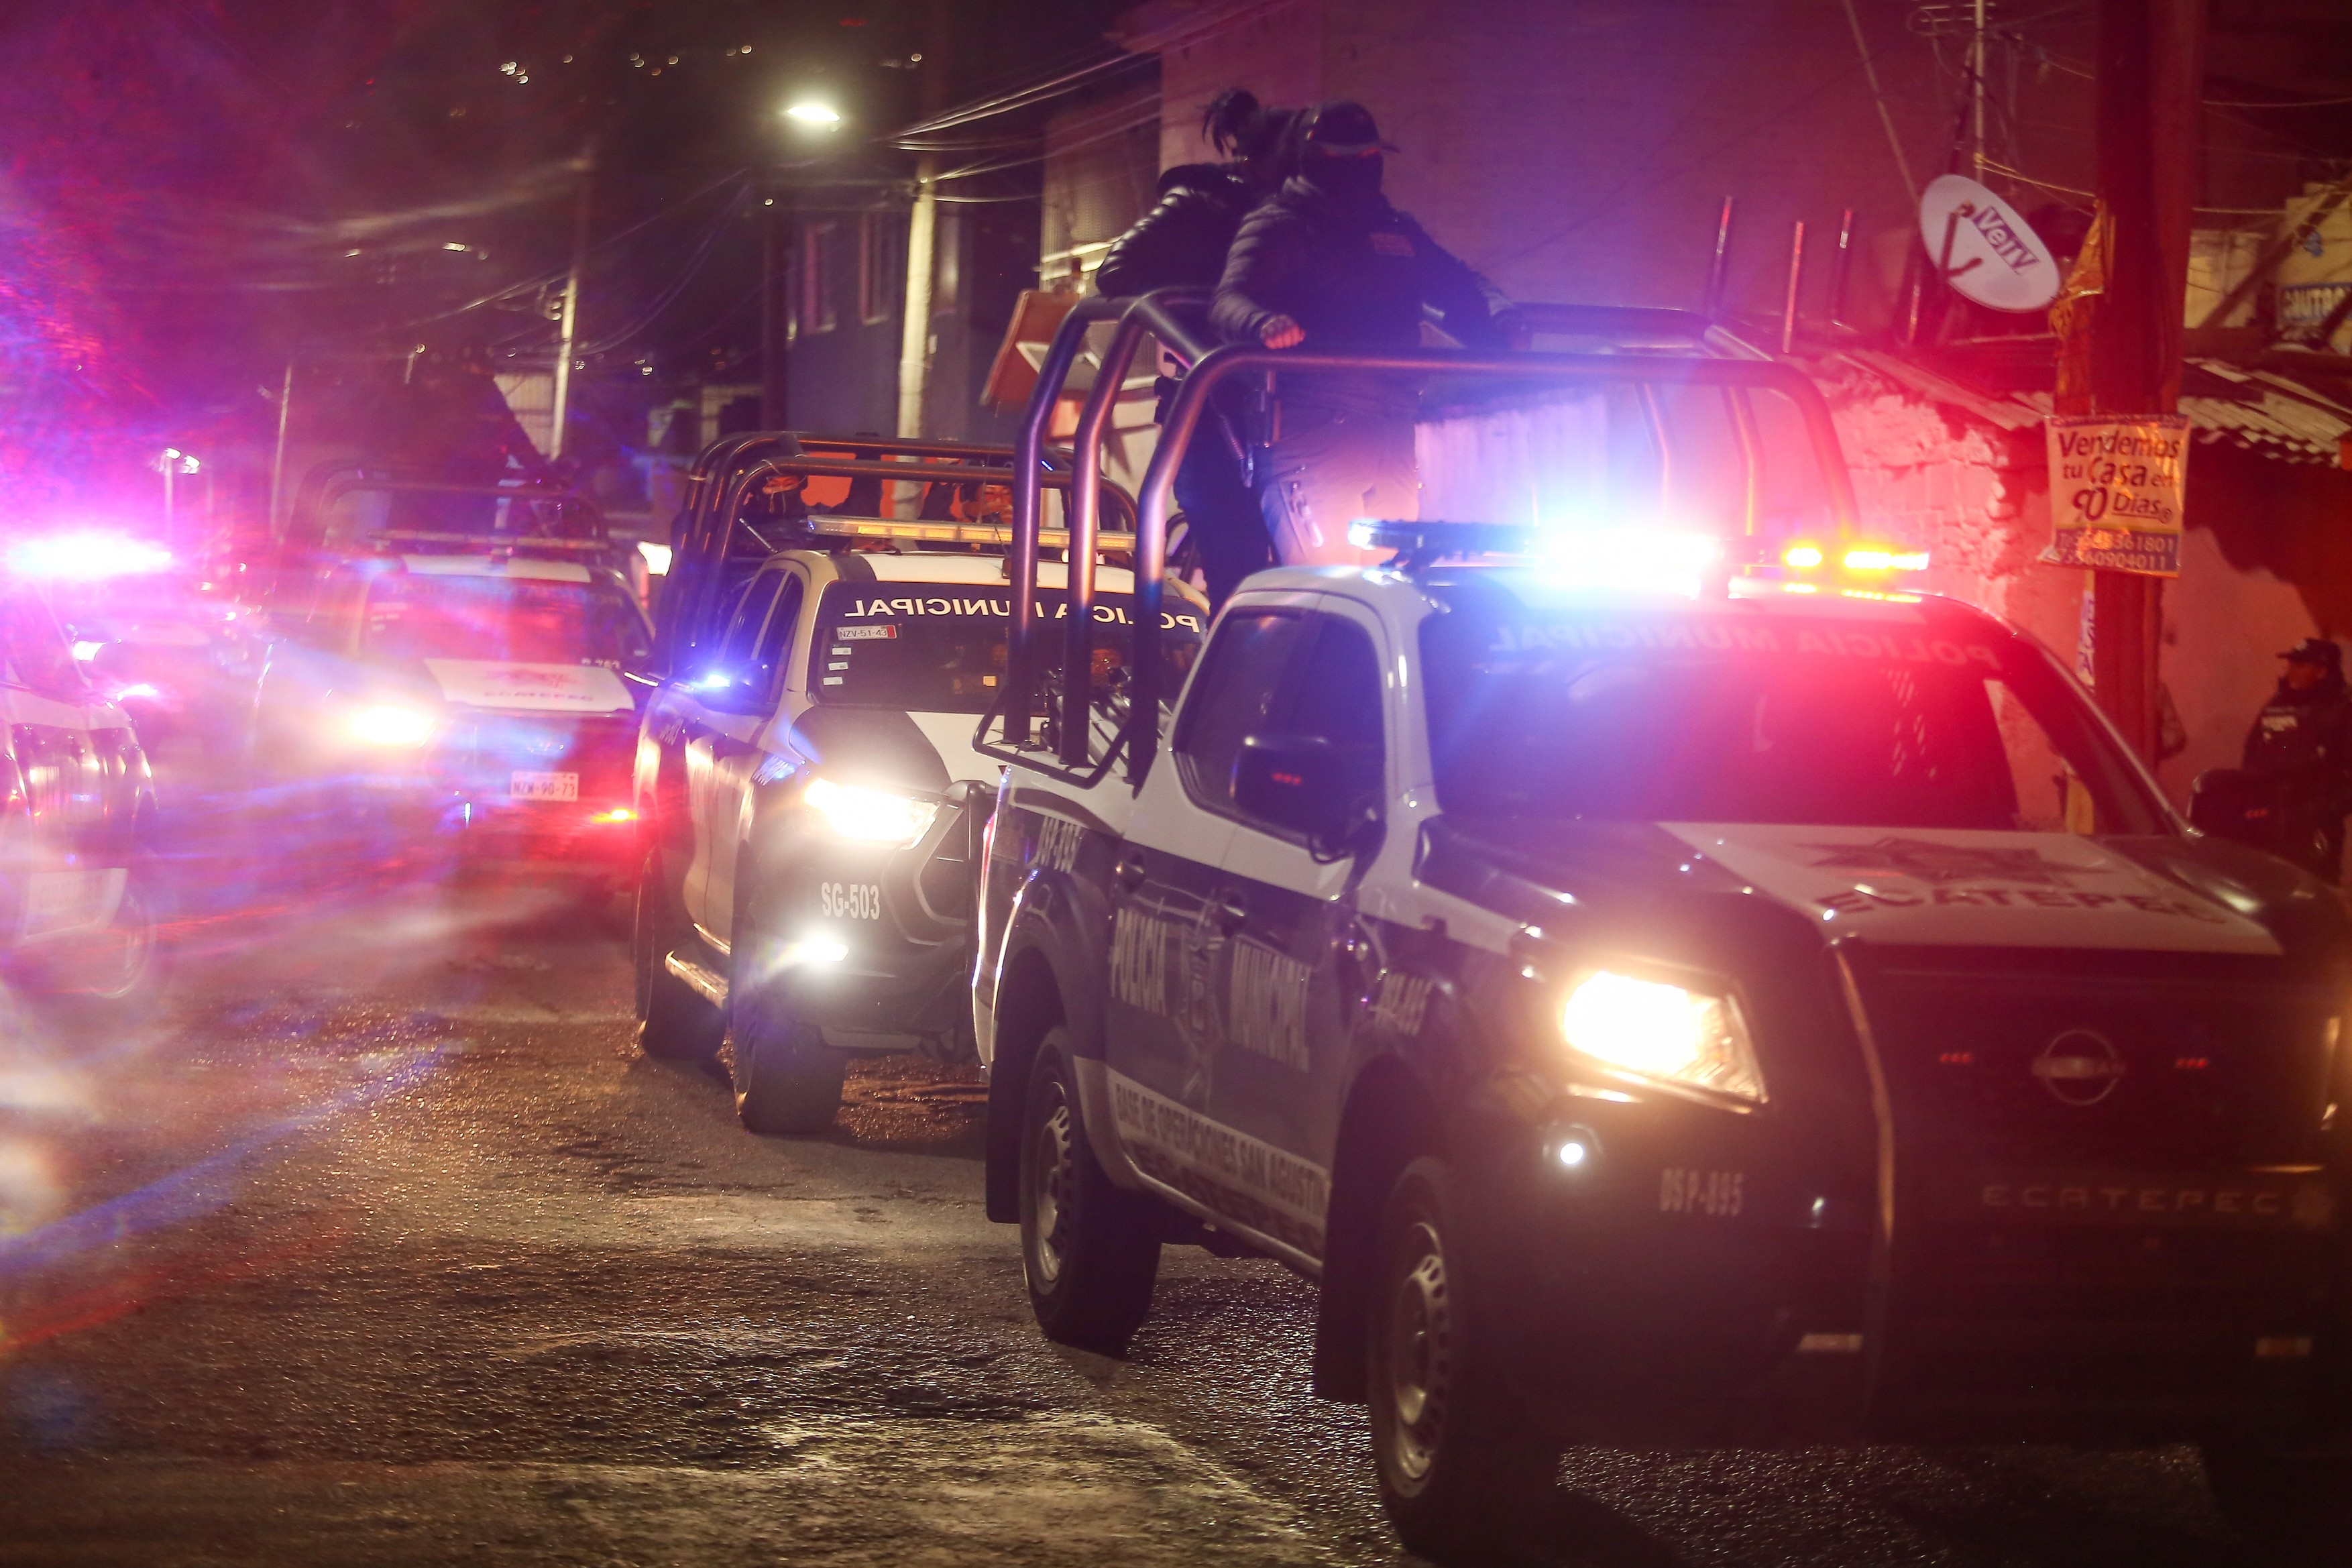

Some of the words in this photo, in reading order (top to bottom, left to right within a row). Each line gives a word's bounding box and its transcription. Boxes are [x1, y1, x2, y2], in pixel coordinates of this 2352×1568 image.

[2058, 430, 2180, 459] Vendemos
[2062, 464, 2082, 480] tu
[2087, 455, 2148, 487] Casa
[839, 629, 887, 638] NZV-51-43
[821, 881, 881, 920] SG-503
[1982, 1184, 2281, 1215] ECATEPEC
